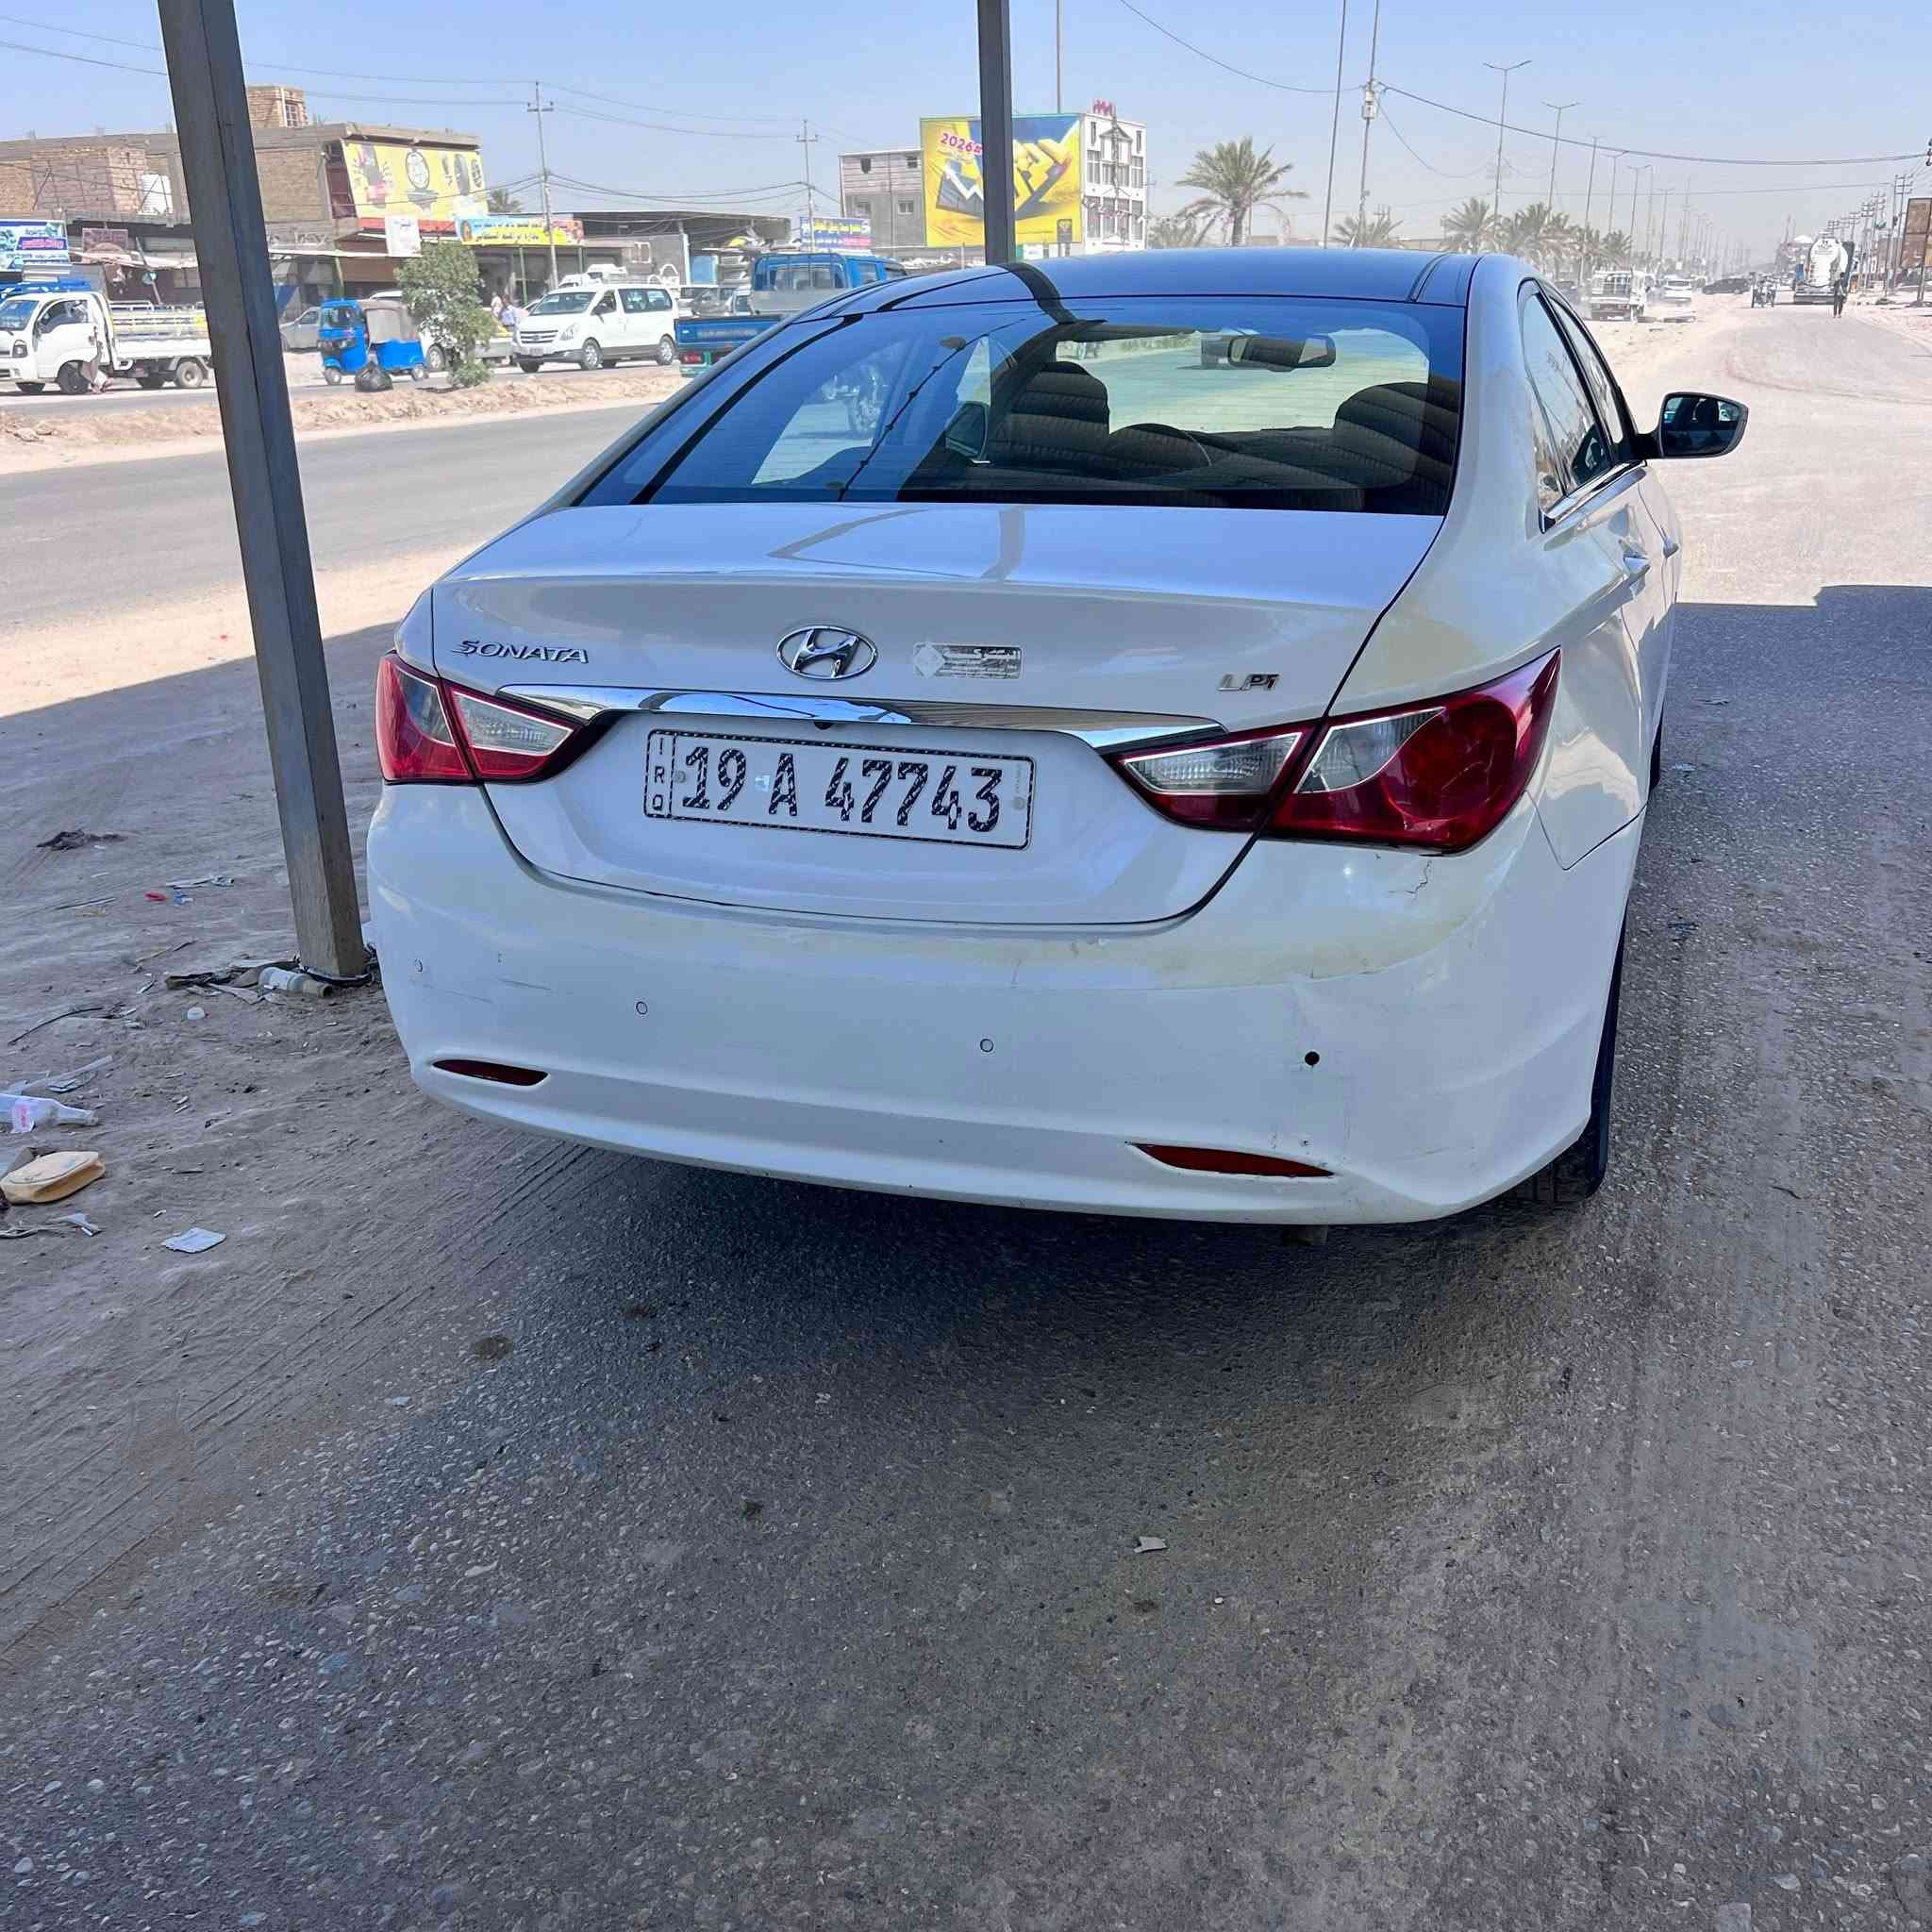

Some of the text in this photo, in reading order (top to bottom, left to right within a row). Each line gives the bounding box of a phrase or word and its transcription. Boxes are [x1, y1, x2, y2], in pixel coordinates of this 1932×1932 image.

[451, 641, 589, 663] SONATA
[682, 746, 747, 811] 19
[768, 753, 798, 817] A
[824, 758, 1003, 833] 47743
